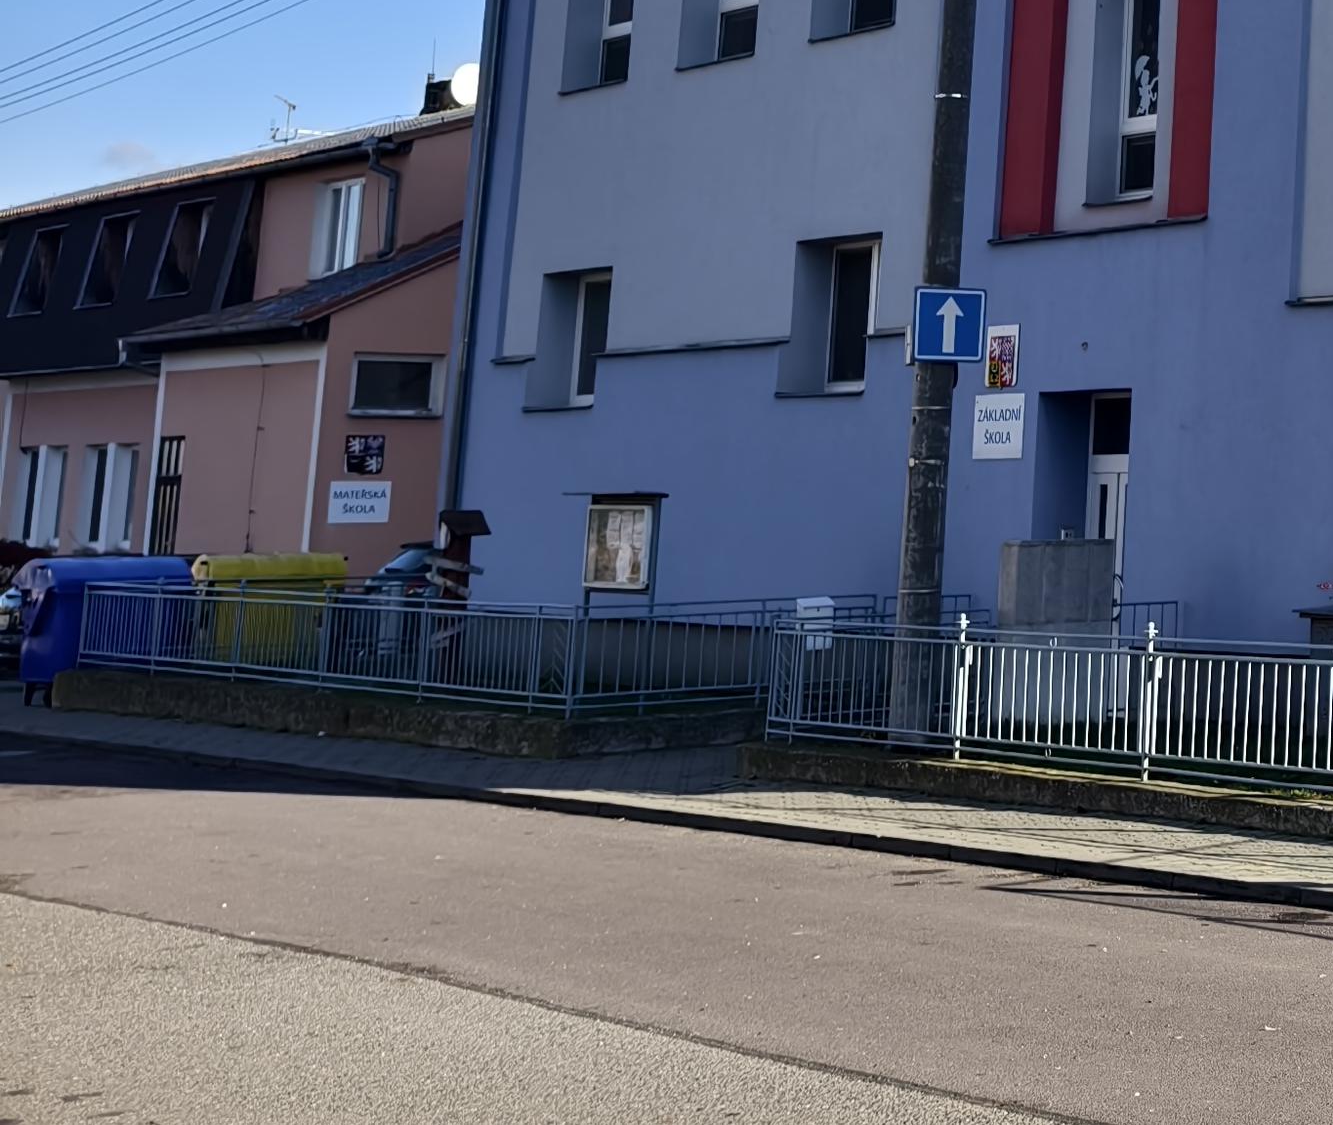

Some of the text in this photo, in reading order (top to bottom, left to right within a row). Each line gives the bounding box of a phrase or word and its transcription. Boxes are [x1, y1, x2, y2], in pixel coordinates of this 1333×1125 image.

[977, 405, 1021, 422] ZÁKLADNÍ
[983, 429, 1011, 445] ŠKOLA
[342, 503, 376, 514] ŠKOLA
